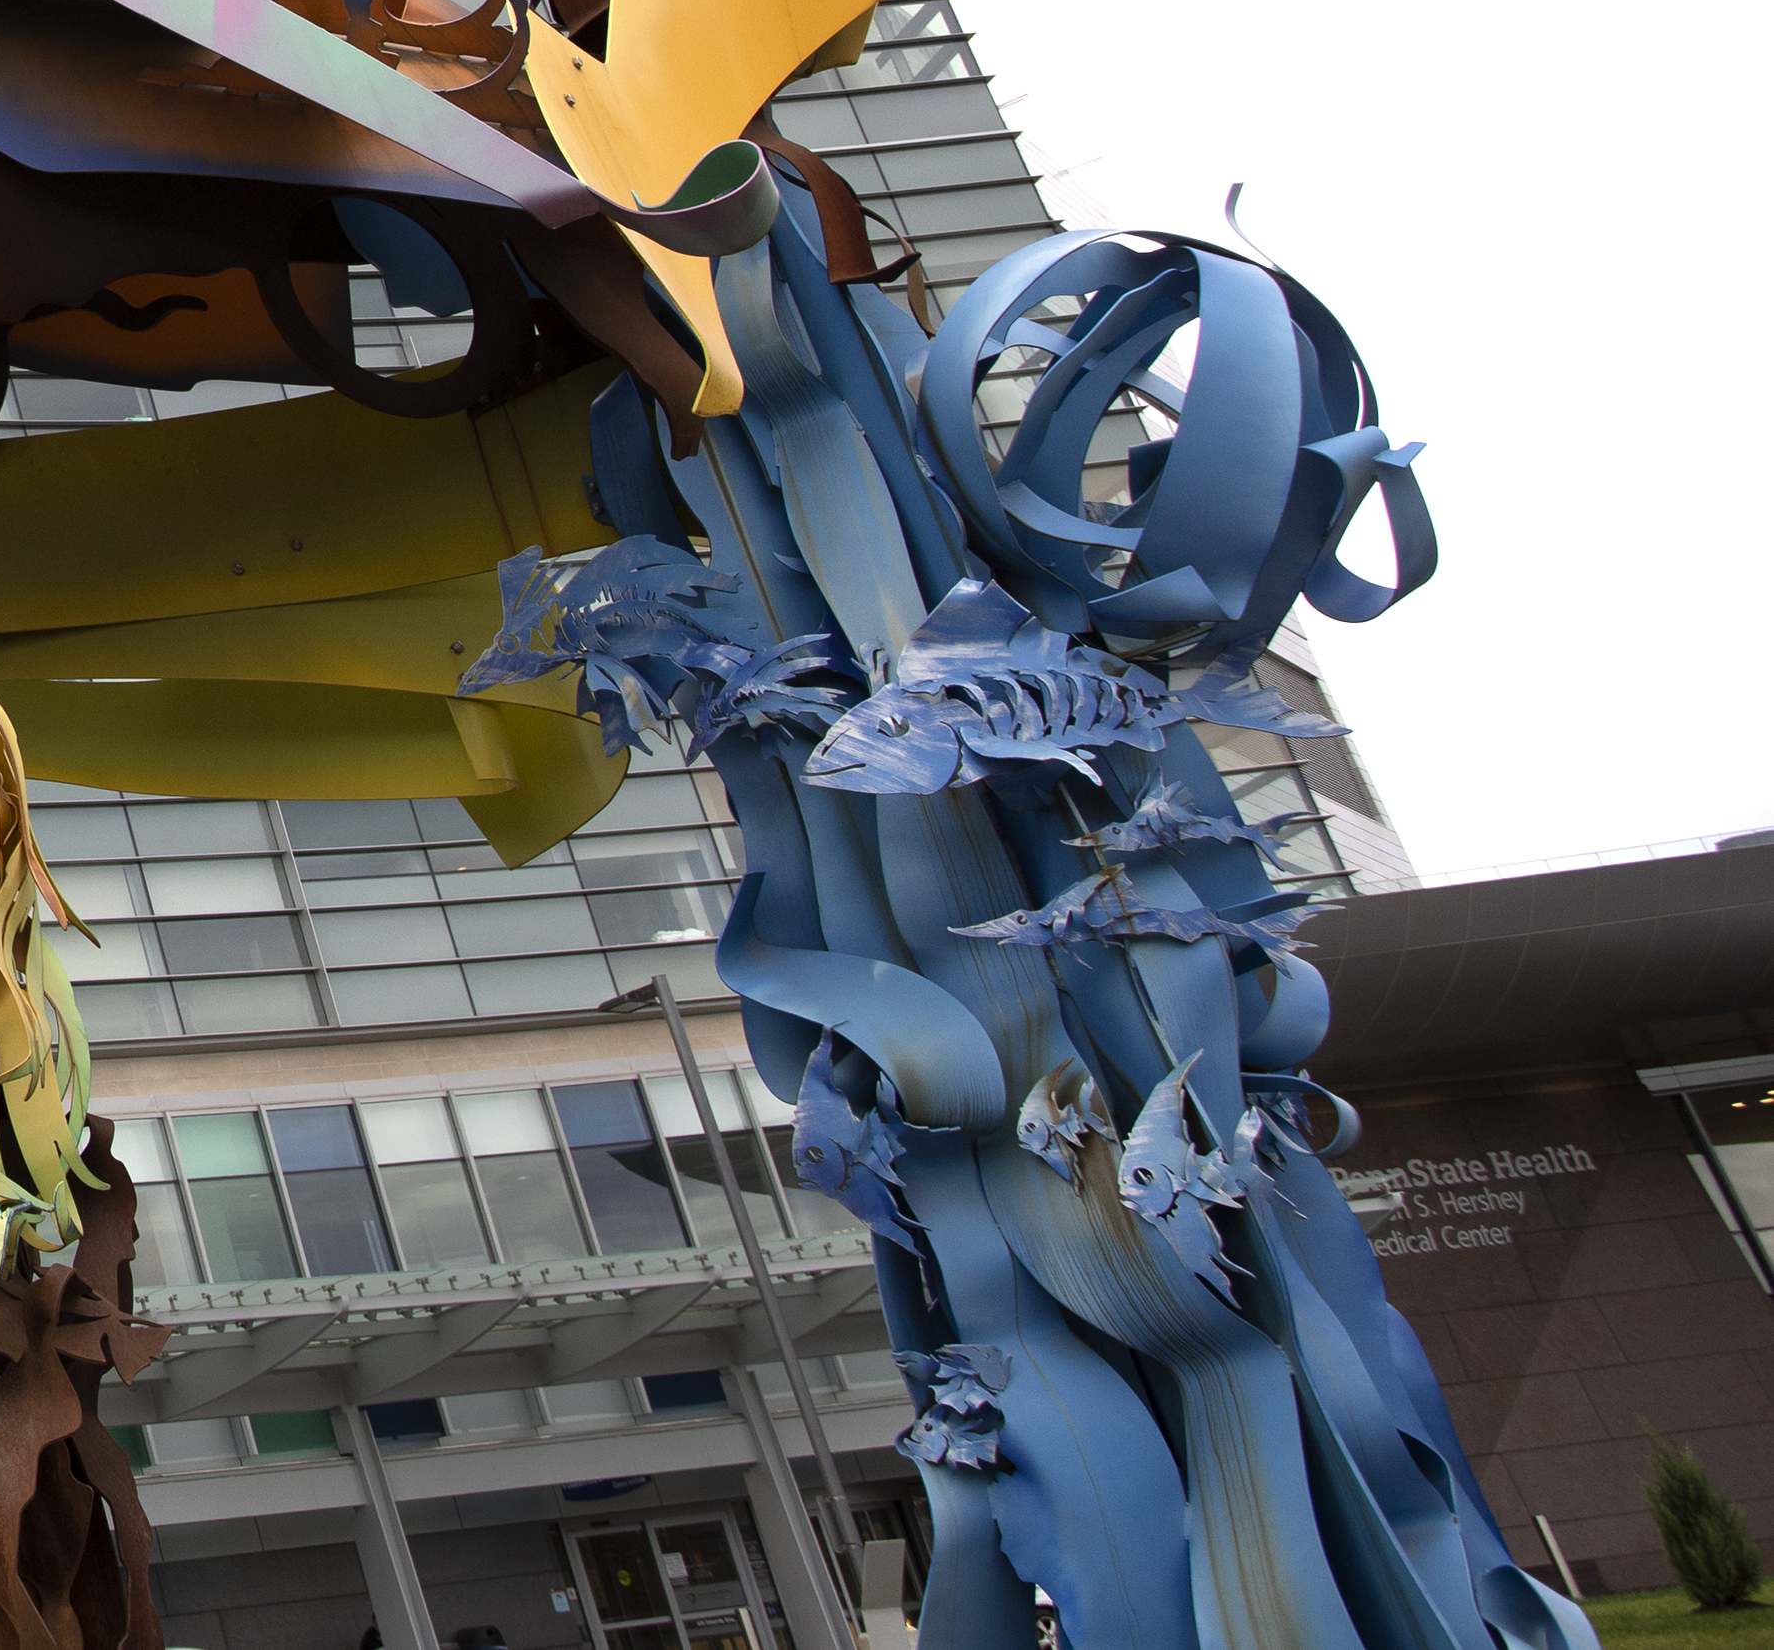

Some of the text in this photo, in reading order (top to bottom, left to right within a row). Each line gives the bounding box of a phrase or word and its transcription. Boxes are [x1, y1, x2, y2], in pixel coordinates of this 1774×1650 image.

[1487, 1144, 1597, 1180] Health
[1414, 1193, 1436, 1219] S.
[1438, 1187, 1527, 1216] Hershey
[1367, 1223, 1514, 1258] edical Center
